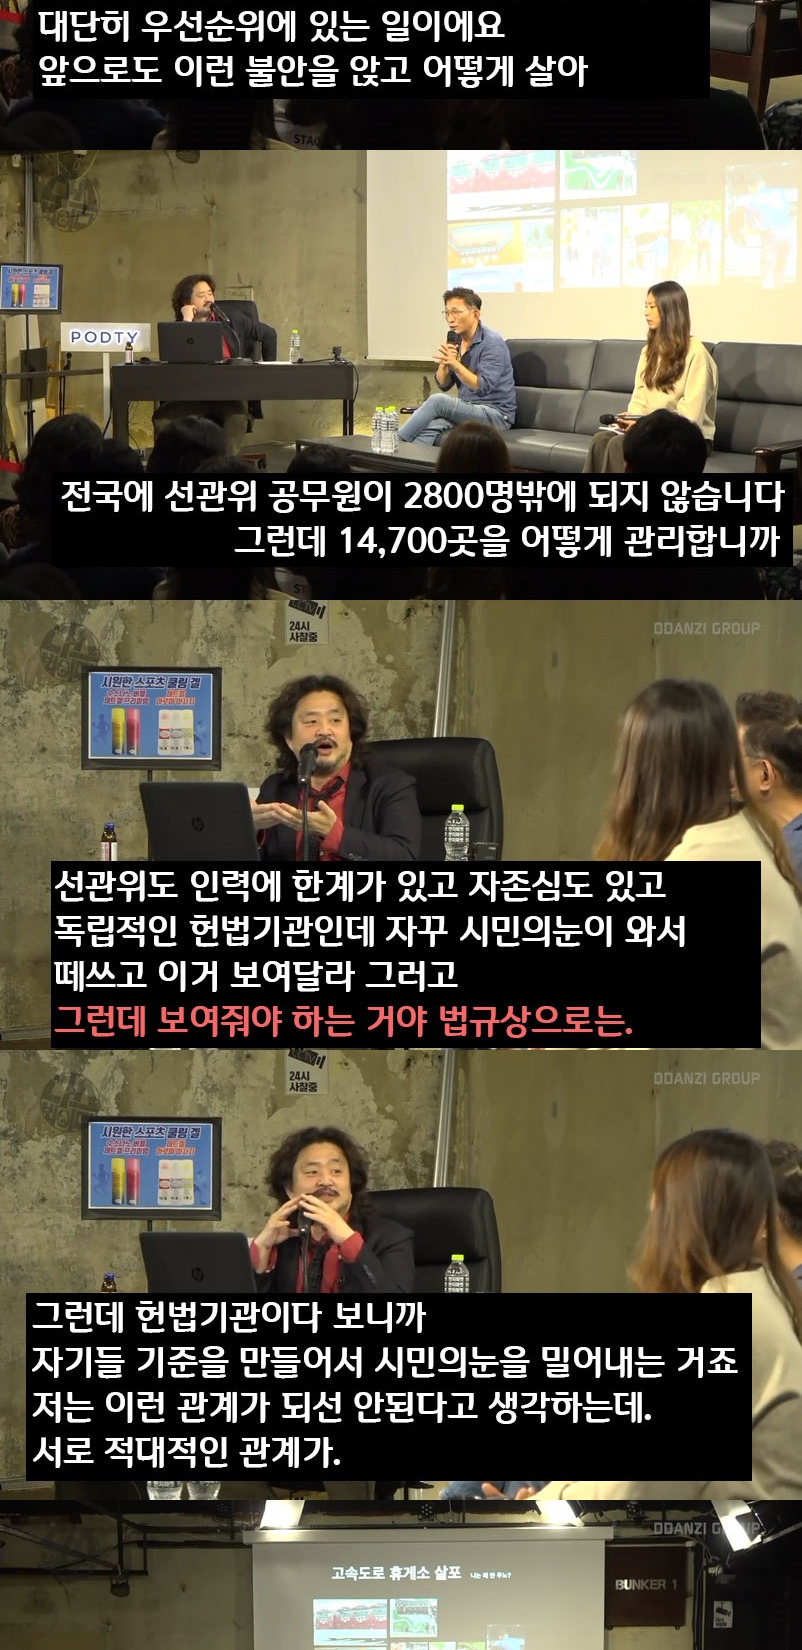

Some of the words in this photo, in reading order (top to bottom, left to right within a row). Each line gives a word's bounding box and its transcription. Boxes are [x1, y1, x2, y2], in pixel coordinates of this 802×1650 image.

[332, 1566, 385, 1580] 고속도로
[389, 1566, 430, 1581] 휴게소
[434, 1565, 461, 1580] 살포
[616, 1579, 666, 1590] BUNKER
